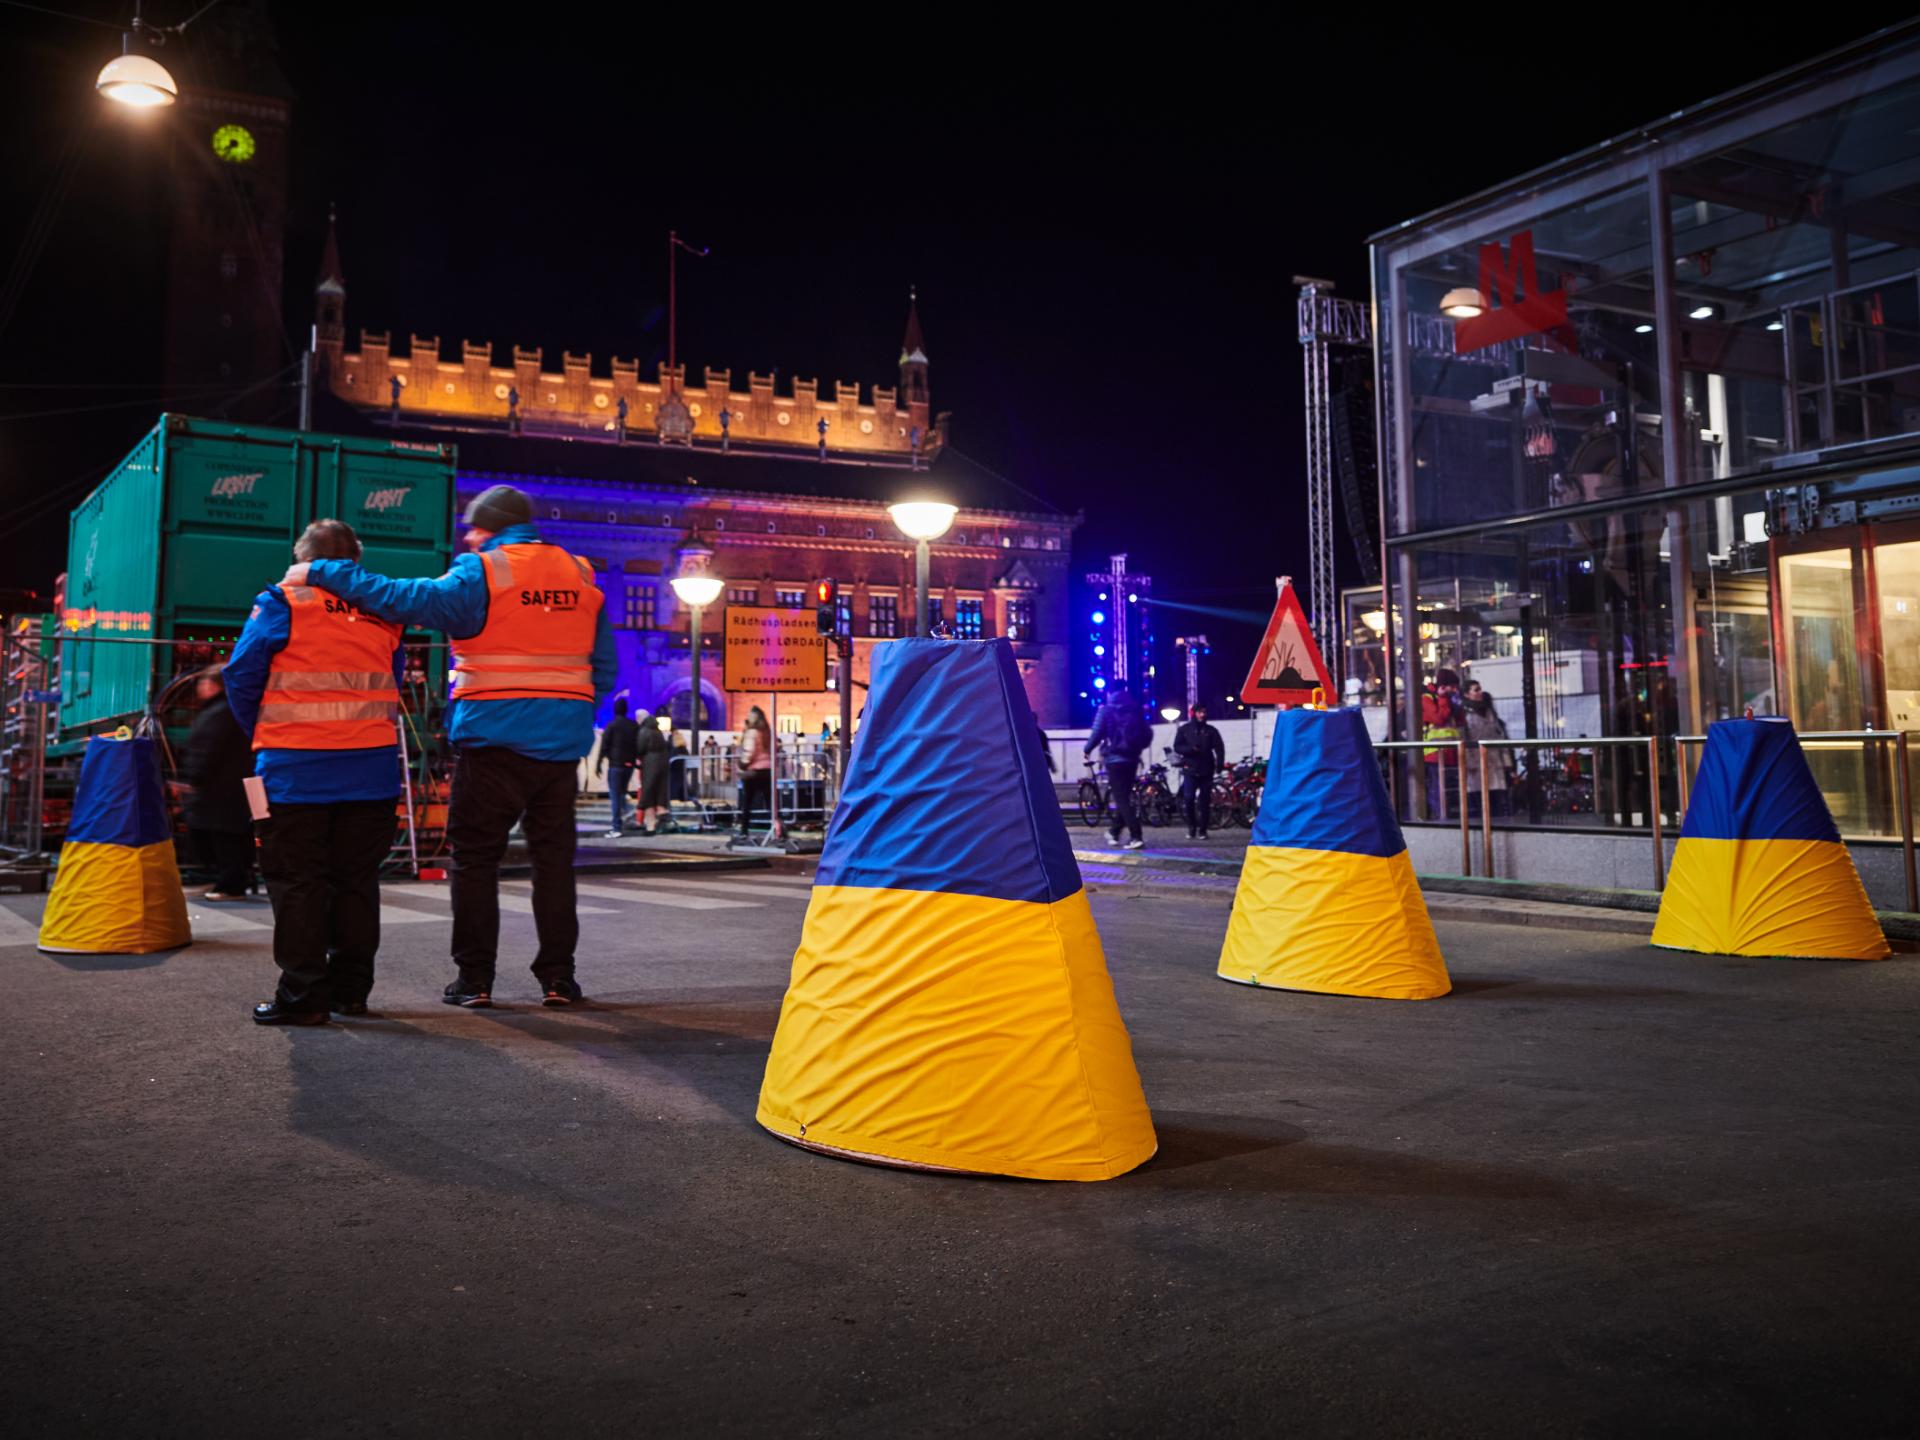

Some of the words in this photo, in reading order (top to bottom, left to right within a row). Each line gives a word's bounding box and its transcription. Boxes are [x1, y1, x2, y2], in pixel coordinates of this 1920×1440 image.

[521, 590, 580, 605] SAFETY
[733, 616, 817, 628] Rådhuspladsen
[728, 637, 771, 648] spærret
[777, 637, 823, 647] LØRDAG
[753, 657, 797, 667] grundet
[741, 677, 810, 686] arrangement
